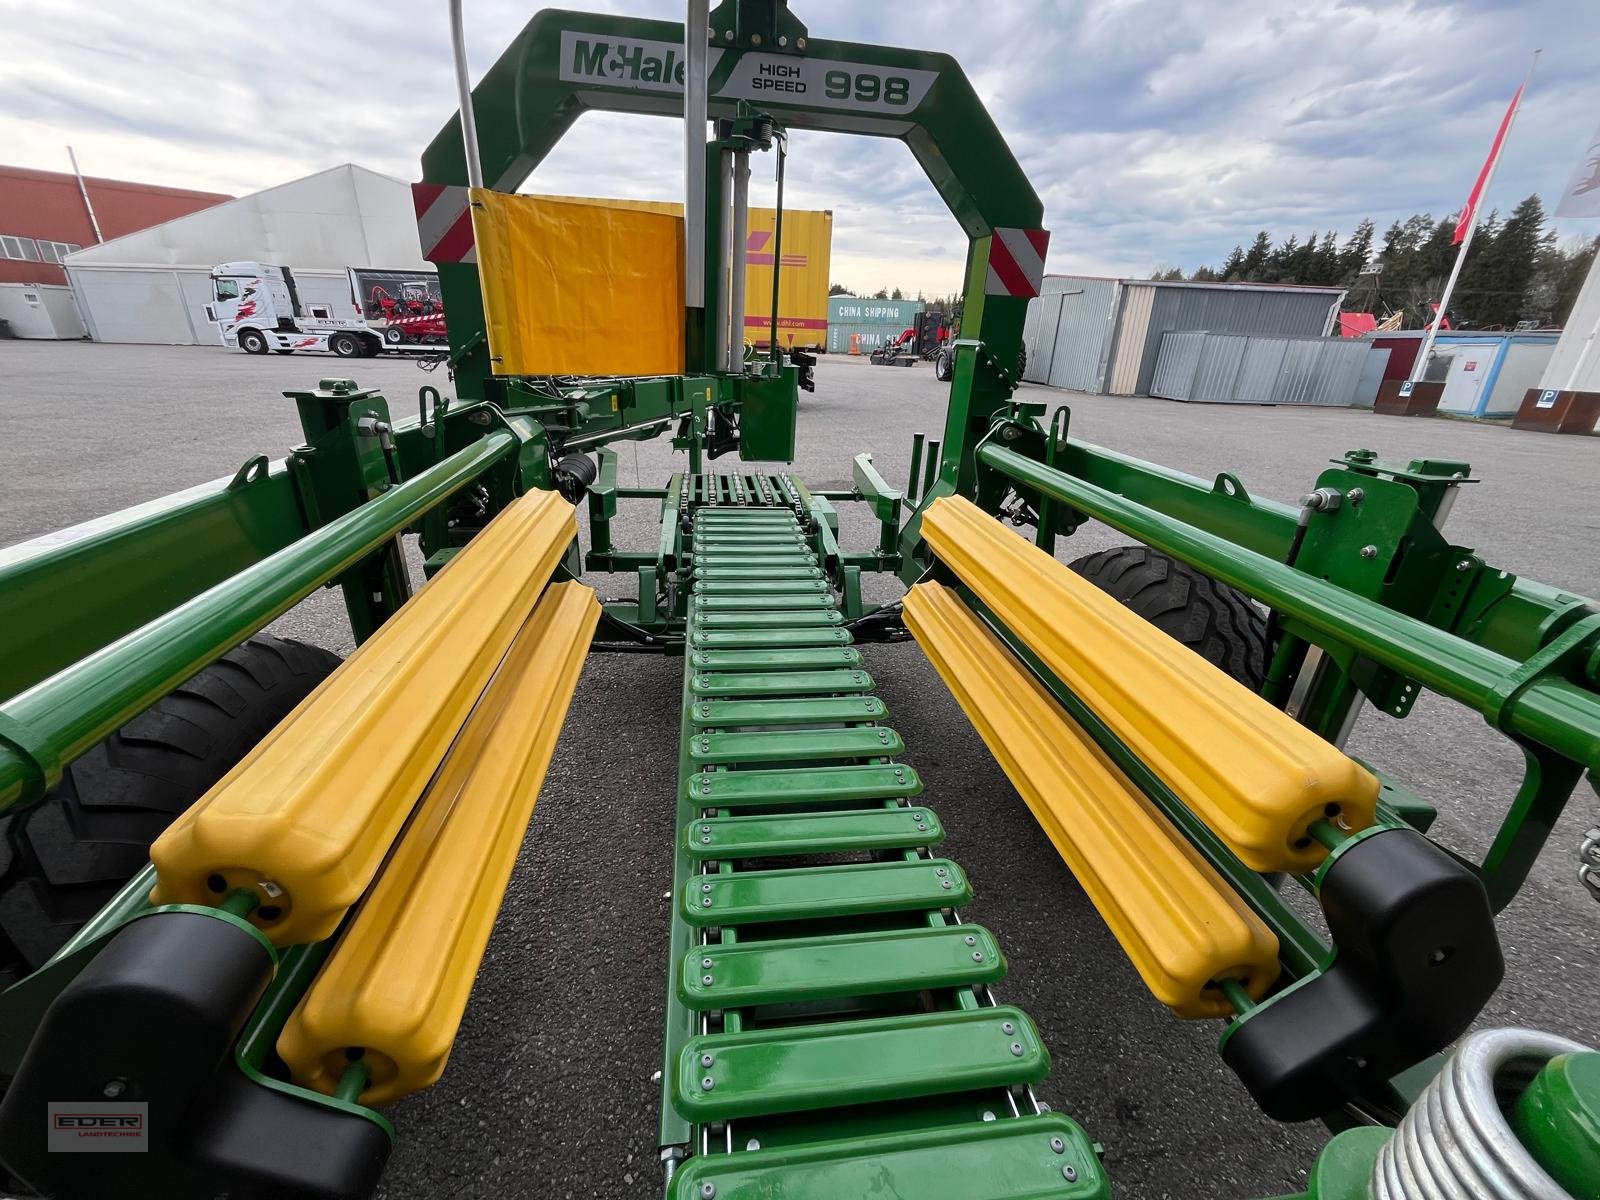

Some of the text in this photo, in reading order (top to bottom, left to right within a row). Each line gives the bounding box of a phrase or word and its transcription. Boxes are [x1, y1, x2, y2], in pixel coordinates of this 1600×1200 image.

[759, 63, 801, 79] HIGH
[751, 79, 807, 94] SPEED
[824, 70, 910, 106] 998
[838, 306, 899, 318] CHINA SHIPPING
[762, 319, 805, 327] w.dhl.com
[855, 333, 880, 346] CHINA
